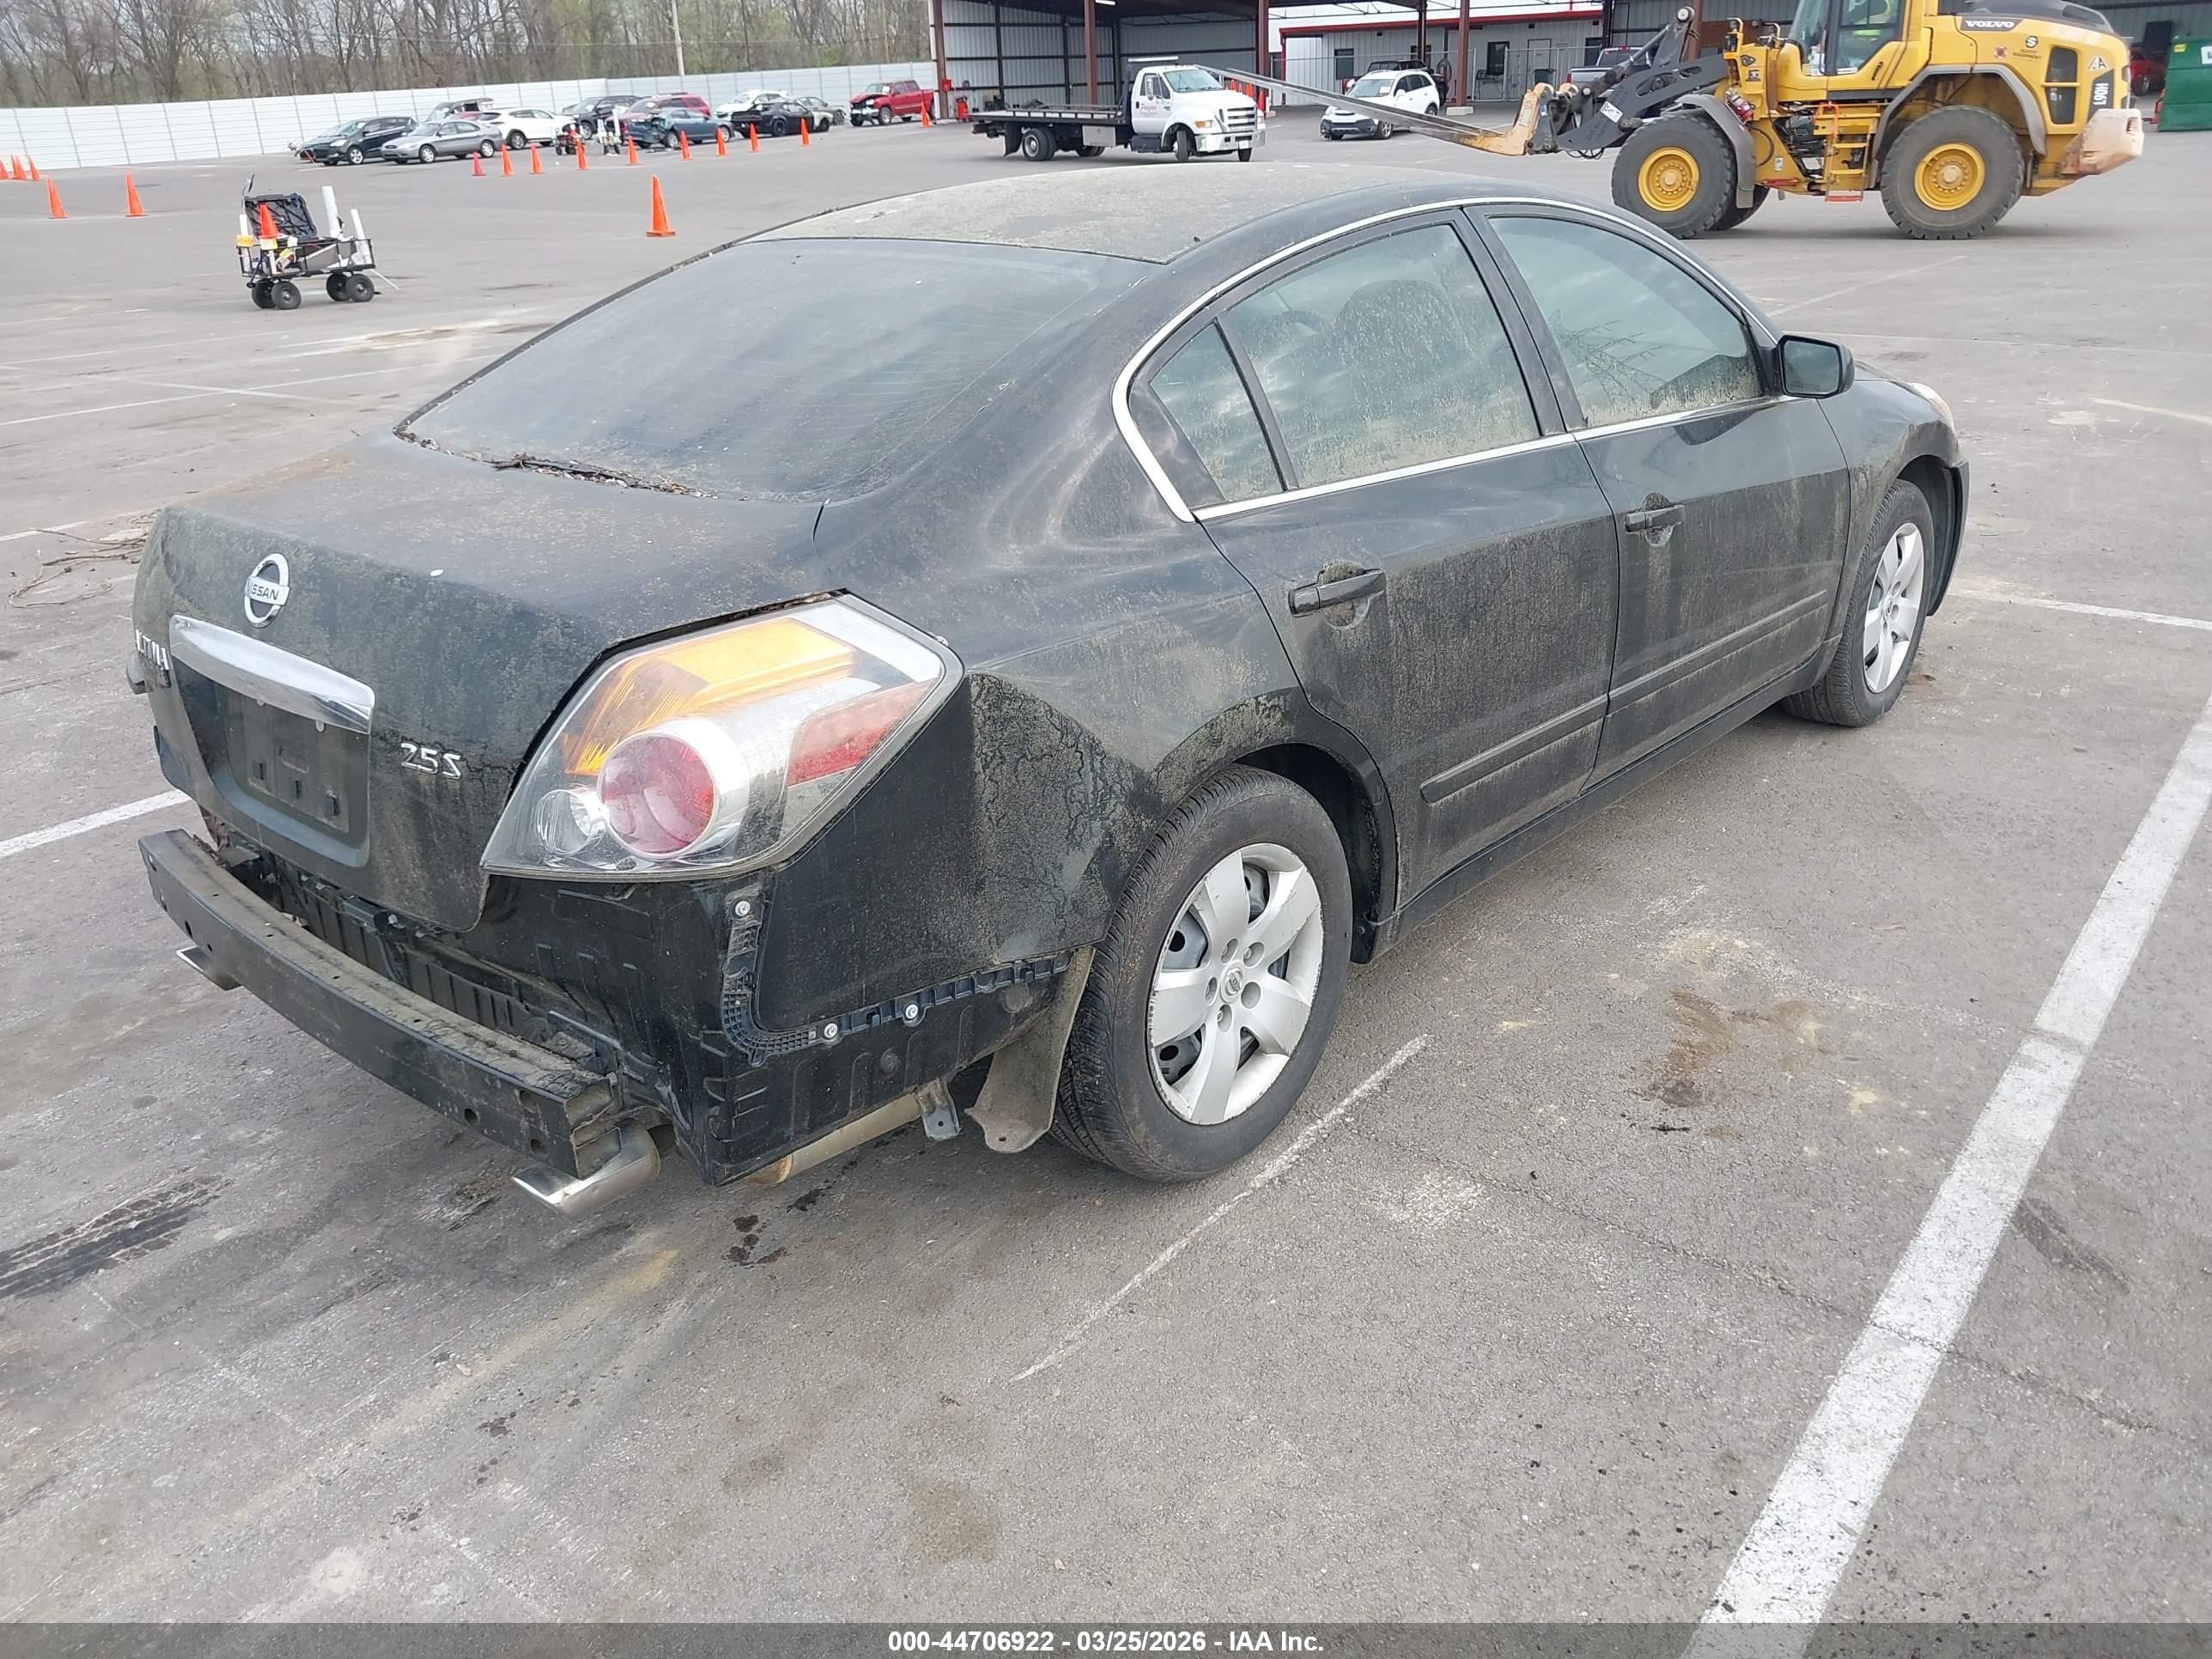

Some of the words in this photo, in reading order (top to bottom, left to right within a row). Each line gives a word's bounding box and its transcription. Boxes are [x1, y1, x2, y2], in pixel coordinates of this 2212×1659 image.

[1965, 20, 2014, 28] VOLVO
[2093, 82, 2110, 106] L90H
[246, 578, 279, 601] NISSAN
